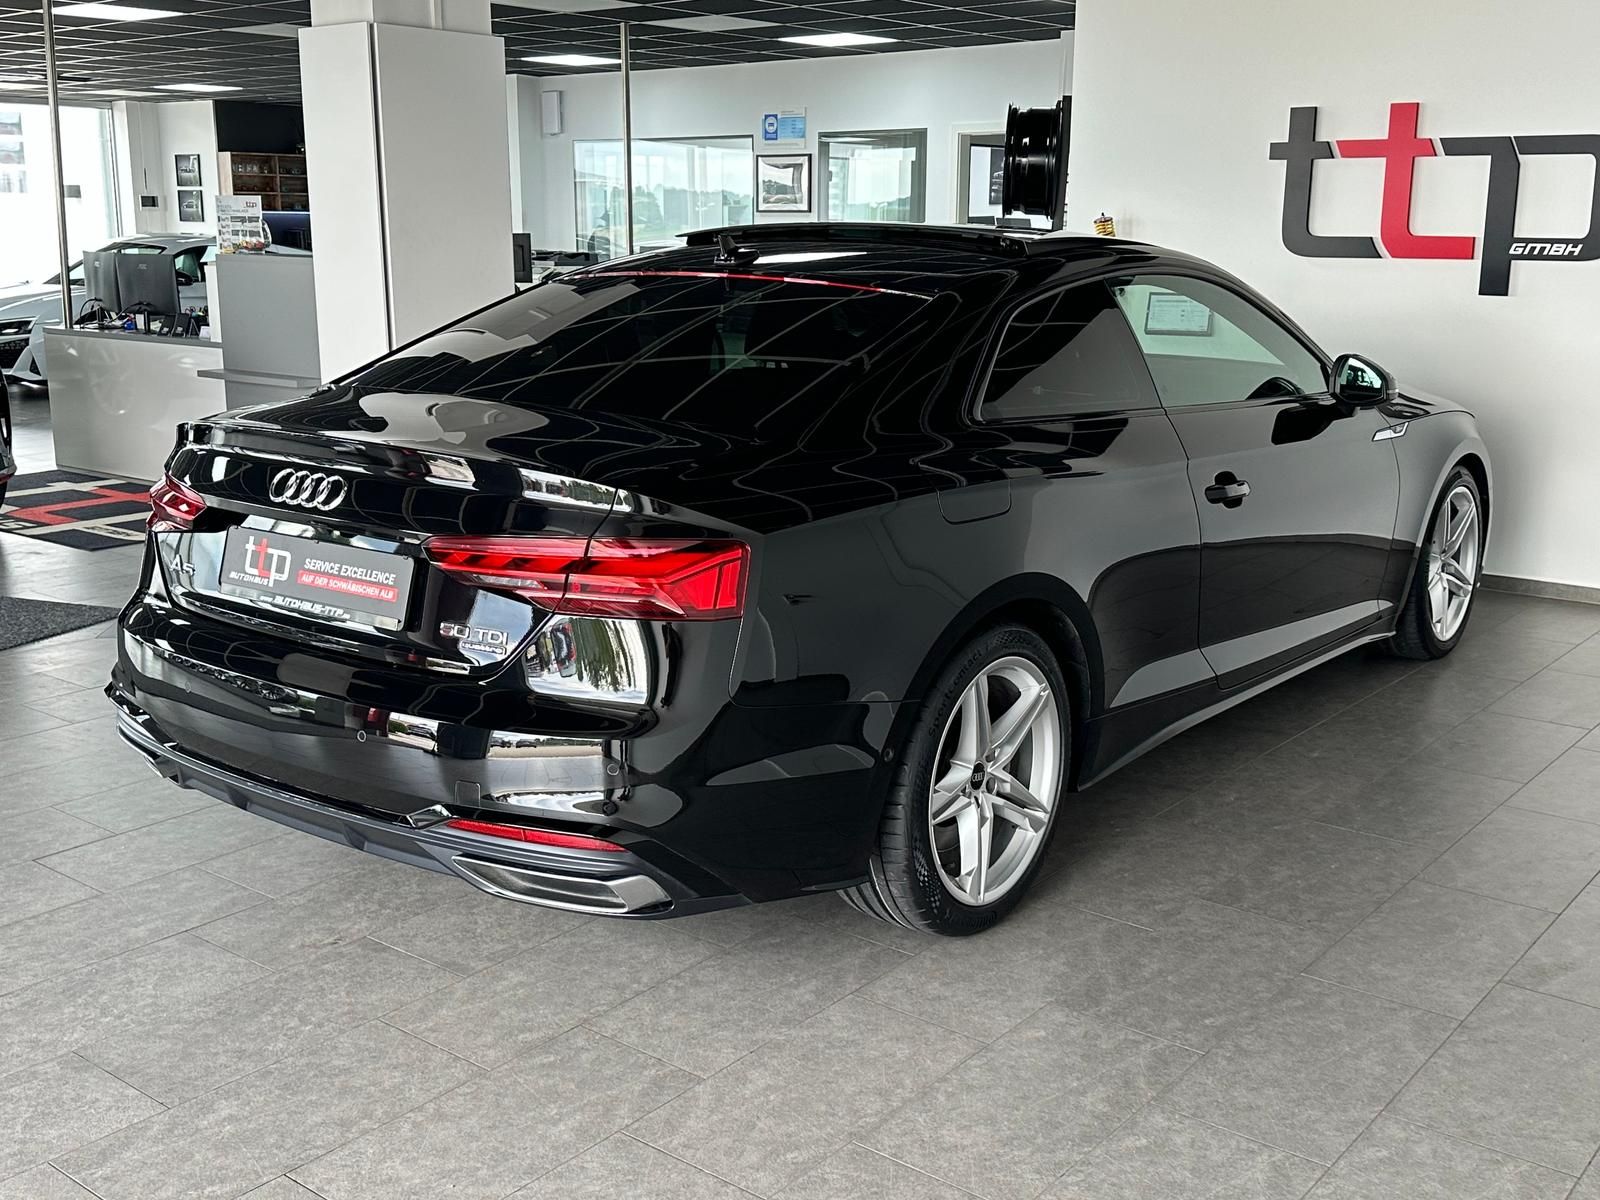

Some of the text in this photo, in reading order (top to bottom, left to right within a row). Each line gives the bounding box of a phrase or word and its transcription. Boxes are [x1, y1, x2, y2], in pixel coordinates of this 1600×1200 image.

[1269, 102, 1600, 296] ttp
[170, 554, 195, 576] A5
[244, 535, 292, 588] ttp
[304, 558, 396, 585] SERVICE EXCELLENCE
[229, 571, 269, 586] AUTOHAUS
[302, 574, 394, 599] AUF DER SCHWÄBISCHEN ALB
[440, 622, 509, 646] 50 TDI
